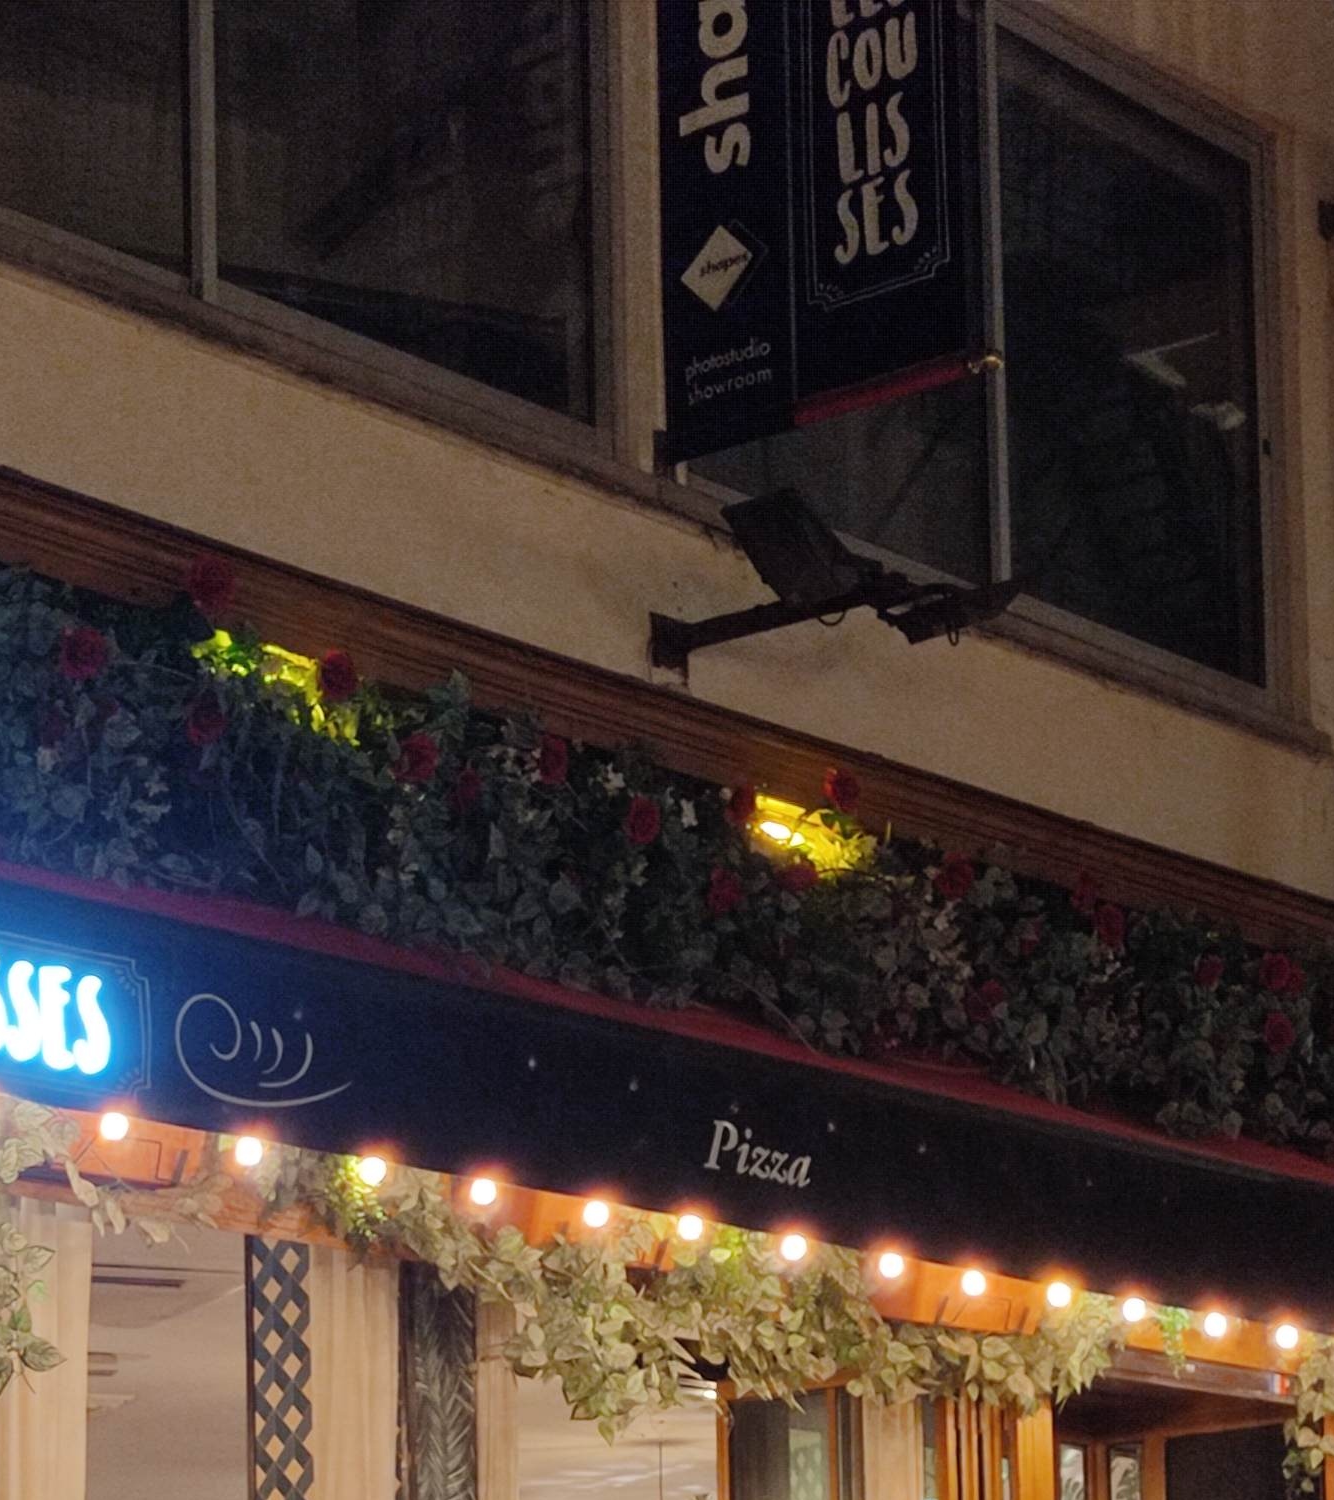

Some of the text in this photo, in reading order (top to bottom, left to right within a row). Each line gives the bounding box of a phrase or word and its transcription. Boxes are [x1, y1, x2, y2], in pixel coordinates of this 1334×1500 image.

[826, 11, 918, 108] COU
[836, 91, 910, 184] LIS
[833, 169, 919, 265] SES
[685, 337, 771, 385] photostudio
[688, 368, 772, 406] showroom
[704, 1120, 812, 1187] Pizza
